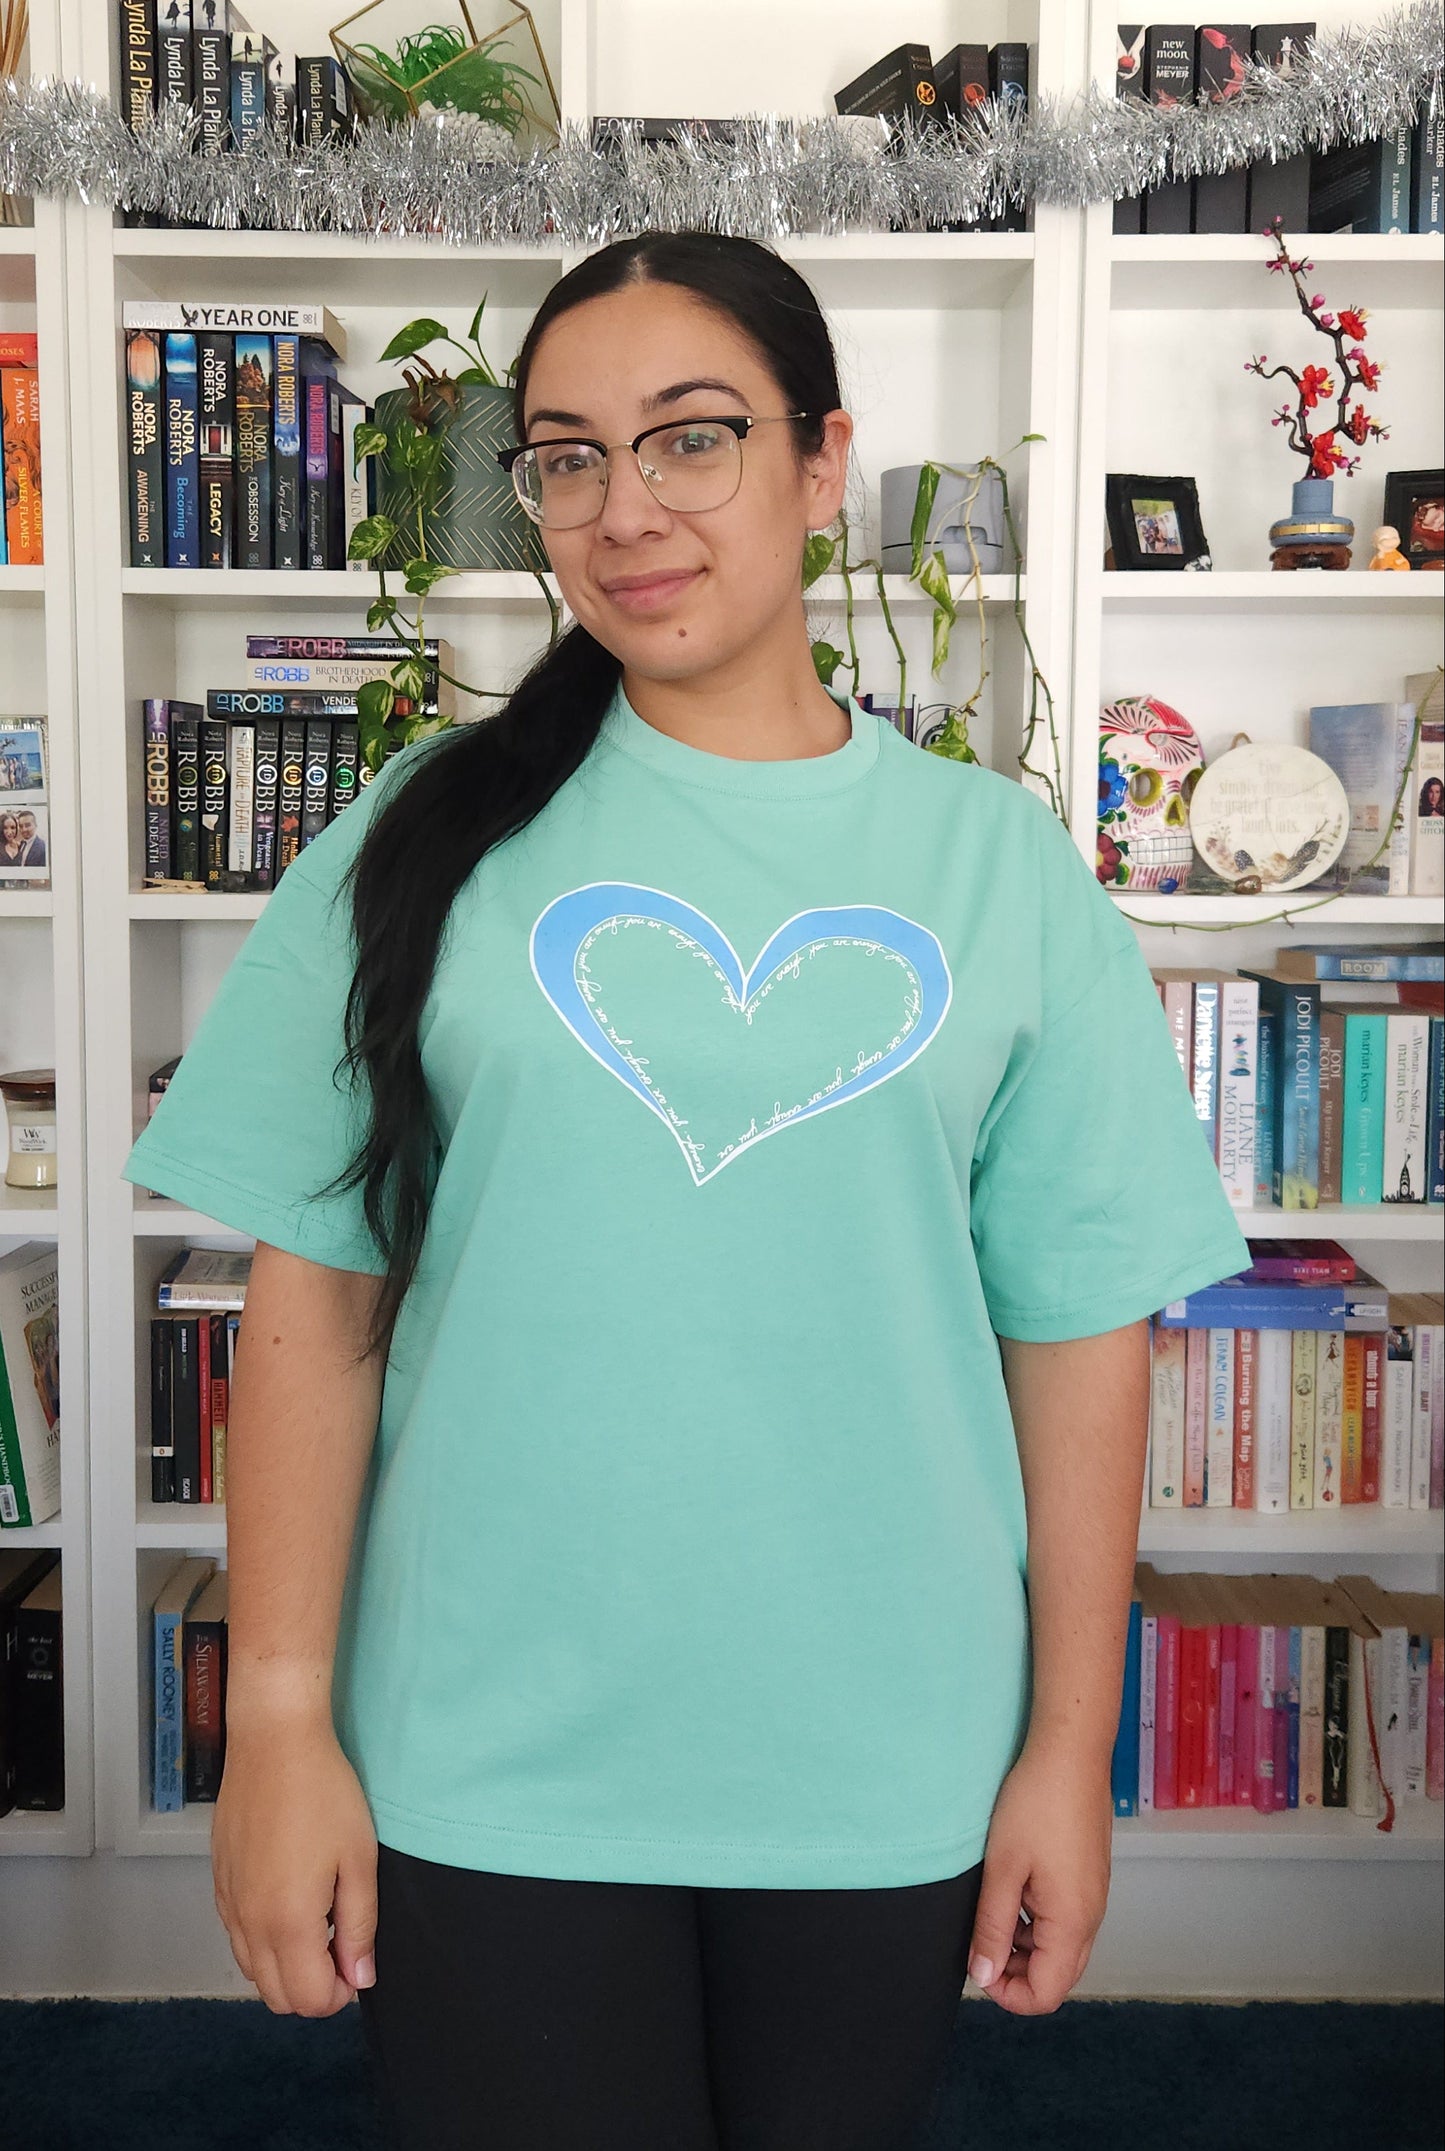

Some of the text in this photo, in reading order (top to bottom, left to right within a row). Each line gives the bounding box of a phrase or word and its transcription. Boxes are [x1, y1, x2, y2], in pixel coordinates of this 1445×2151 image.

[130, 50, 152, 71] La
[164, 38, 185, 79] Lynda
[199, 37, 220, 80] Lynda
[1156, 50, 1190, 61] moon
[1161, 40, 1184, 49] new
[203, 87, 221, 105] La
[307, 64, 323, 109] Lynda La
[1155, 70, 1189, 78] MEYER
[239, 71, 256, 125] Lynda La
[273, 86, 288, 117] Lynda
[201, 308, 254, 326] YEAR
[257, 310, 299, 327] ONE
[278, 342, 294, 372] NORA
[30, 380, 39, 423] SARAH
[203, 348, 215, 413] ROBERTS
[214, 360, 226, 402] NORA
[278, 375, 296, 425] ROBERTS
[310, 385, 324, 410] NORA
[15, 389, 26, 425] MAAS
[132, 391, 144, 456] ROBERTS
[143, 402, 155, 445] NORA
[168, 398, 182, 466] ROBERTS
[181, 409, 194, 455] NORA
[239, 410, 254, 475] ROBERTS
[254, 422, 267, 464] NORA
[310, 413, 325, 455] ROBERTS
[19, 504, 30, 549] FLAMES
[136, 469, 150, 543] AWAKENING
[173, 477, 188, 540] Becoming
[209, 482, 222, 538] LEGACY
[248, 481, 259, 543] OBSESSION
[288, 639, 347, 658] ROBB
[264, 667, 310, 682] ROBB
[230, 694, 358, 713] ROBB VENDE
[147, 743, 169, 807] ROBB
[178, 750, 198, 813] ROBB
[204, 750, 226, 813] ROBB
[256, 750, 277, 813] ROBB
[281, 750, 304, 813] ROBB
[306, 751, 328, 813] ROBB
[149, 813, 158, 864] IN DEATH
[1294, 995, 1312, 1099] JODI PICOULT
[1320, 1037, 1330, 1090] PICOULT
[1330, 1048, 1340, 1078] JODI
[1359, 1029, 1373, 1069] marian
[1396, 1044, 1408, 1087] marian
[1356, 1073, 1372, 1103] keyes
[1222, 1084, 1238, 1180] MORIARTY
[1239, 1103, 1254, 1163] LIANE
[1238, 1354, 1252, 1463] Burning the Map
[162, 1626, 175, 1660] SALLY
[163, 1667, 176, 1721] ROONEY
[194, 1644, 213, 1724] SILKWORM
